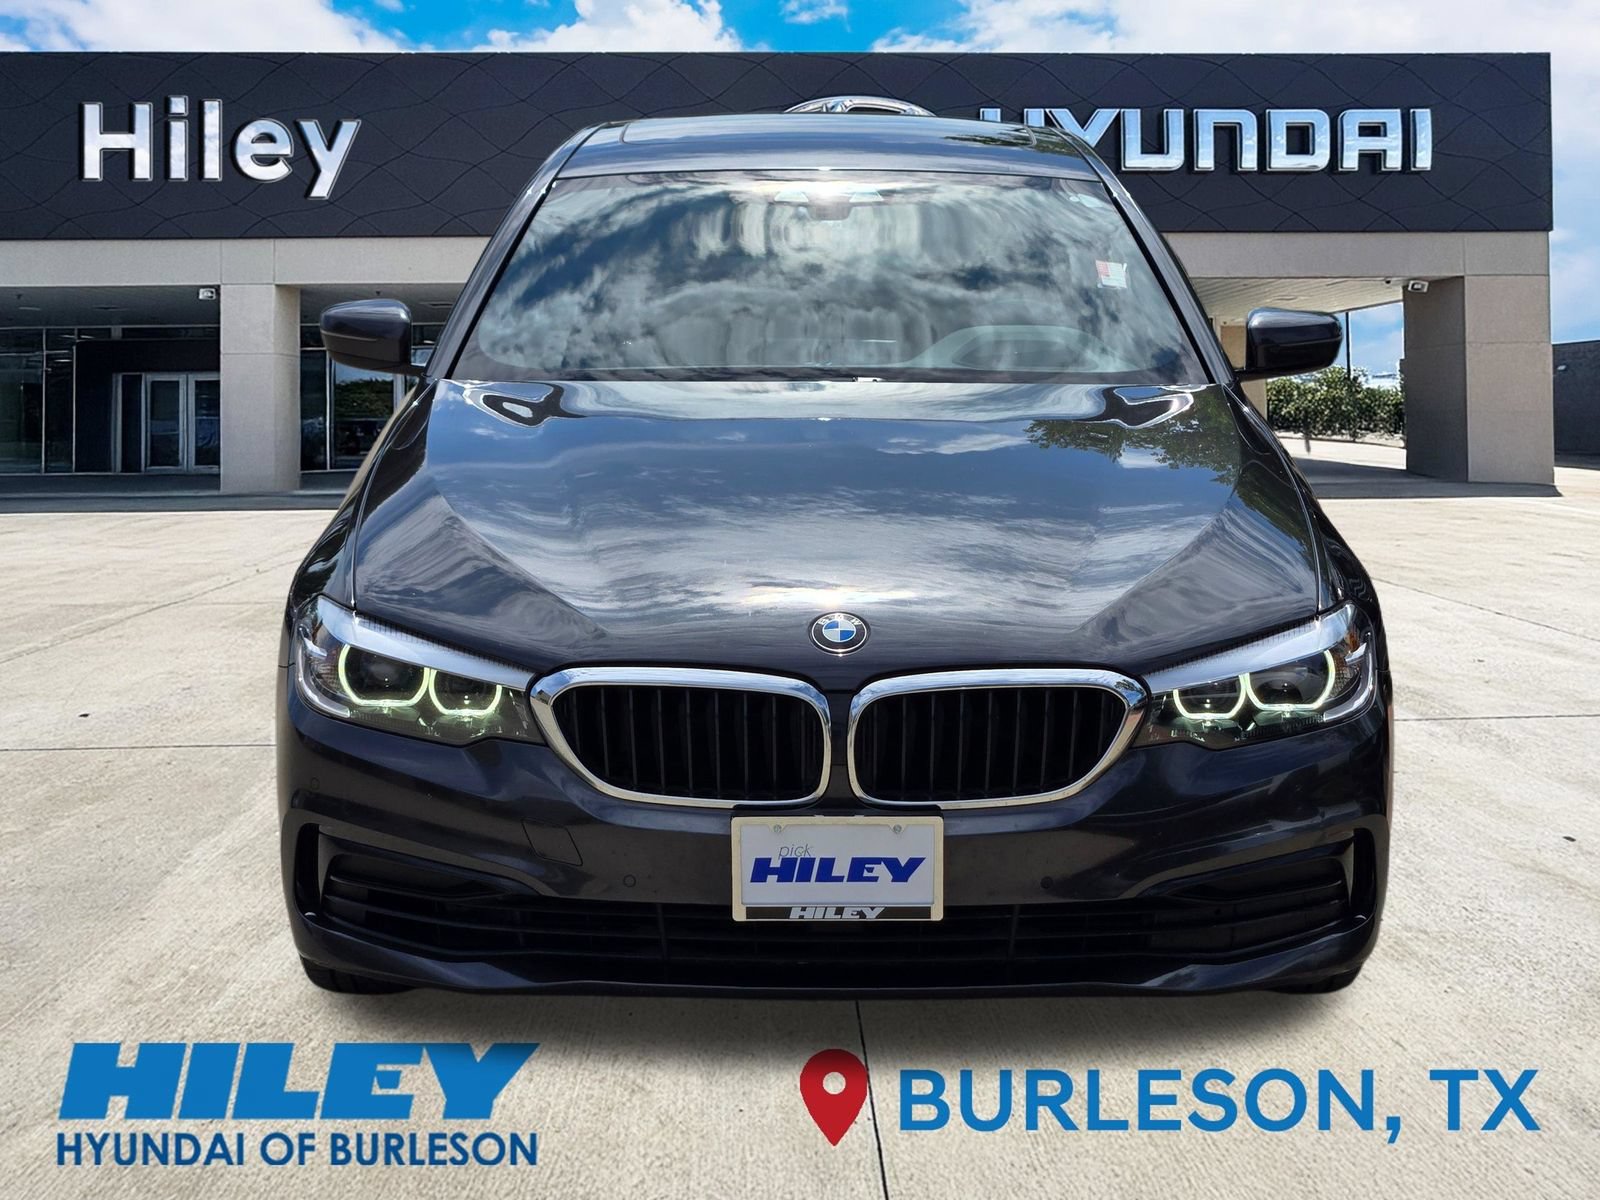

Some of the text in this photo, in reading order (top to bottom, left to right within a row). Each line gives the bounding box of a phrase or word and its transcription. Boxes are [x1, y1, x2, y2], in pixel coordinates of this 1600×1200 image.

[80, 95, 361, 200] Hiley
[980, 108, 1433, 172] YUNDAI
[778, 844, 812, 860] pick
[750, 857, 926, 883] HILEY
[789, 906, 886, 920] HILEY
